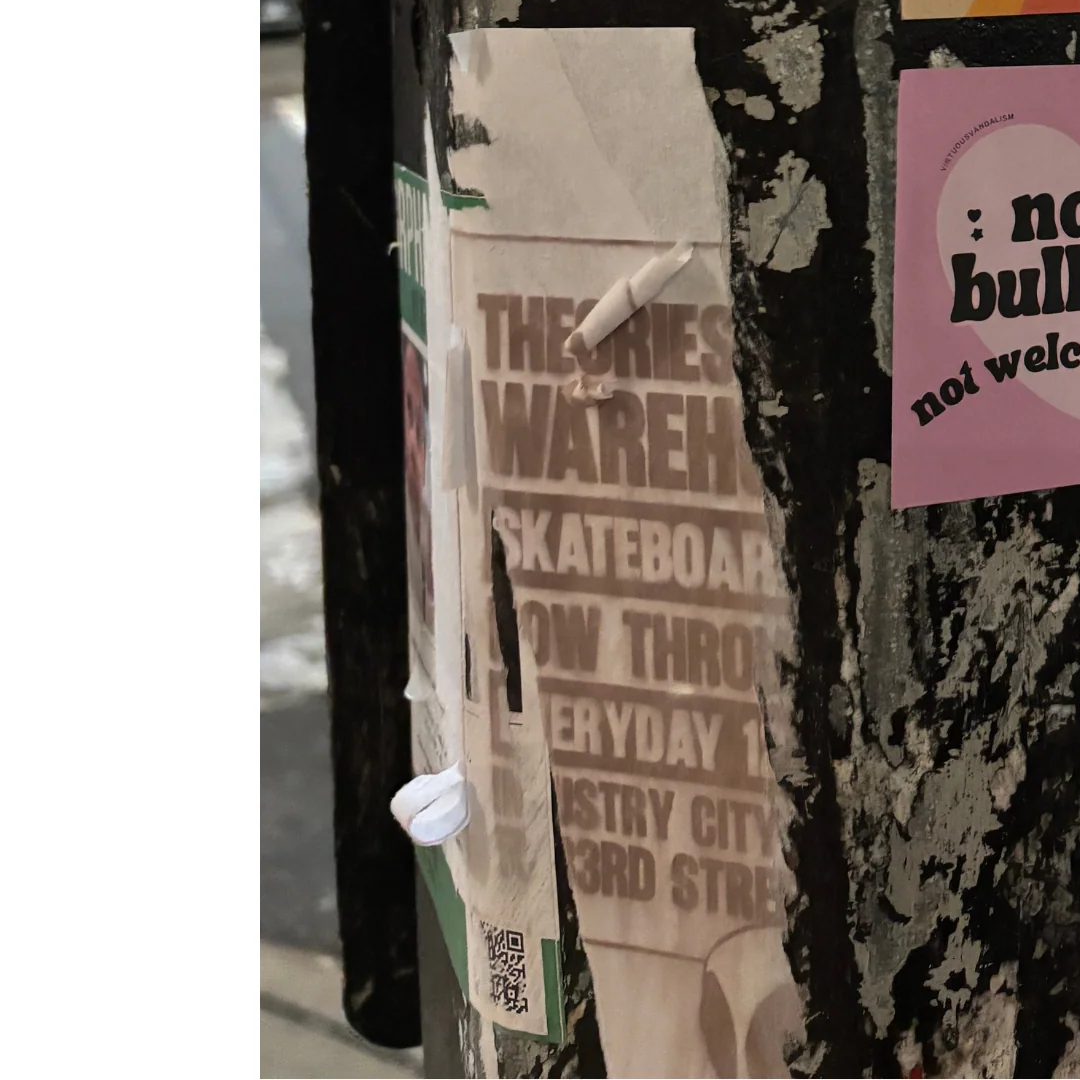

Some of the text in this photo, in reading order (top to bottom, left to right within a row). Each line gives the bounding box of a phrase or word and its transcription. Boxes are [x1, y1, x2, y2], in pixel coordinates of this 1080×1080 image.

[940, 113, 1015, 172] VIRTUOUSVANDALISM
[910, 360, 981, 426] not
[622, 609, 763, 691] THRO
[551, 694, 723, 771] ERYDAY
